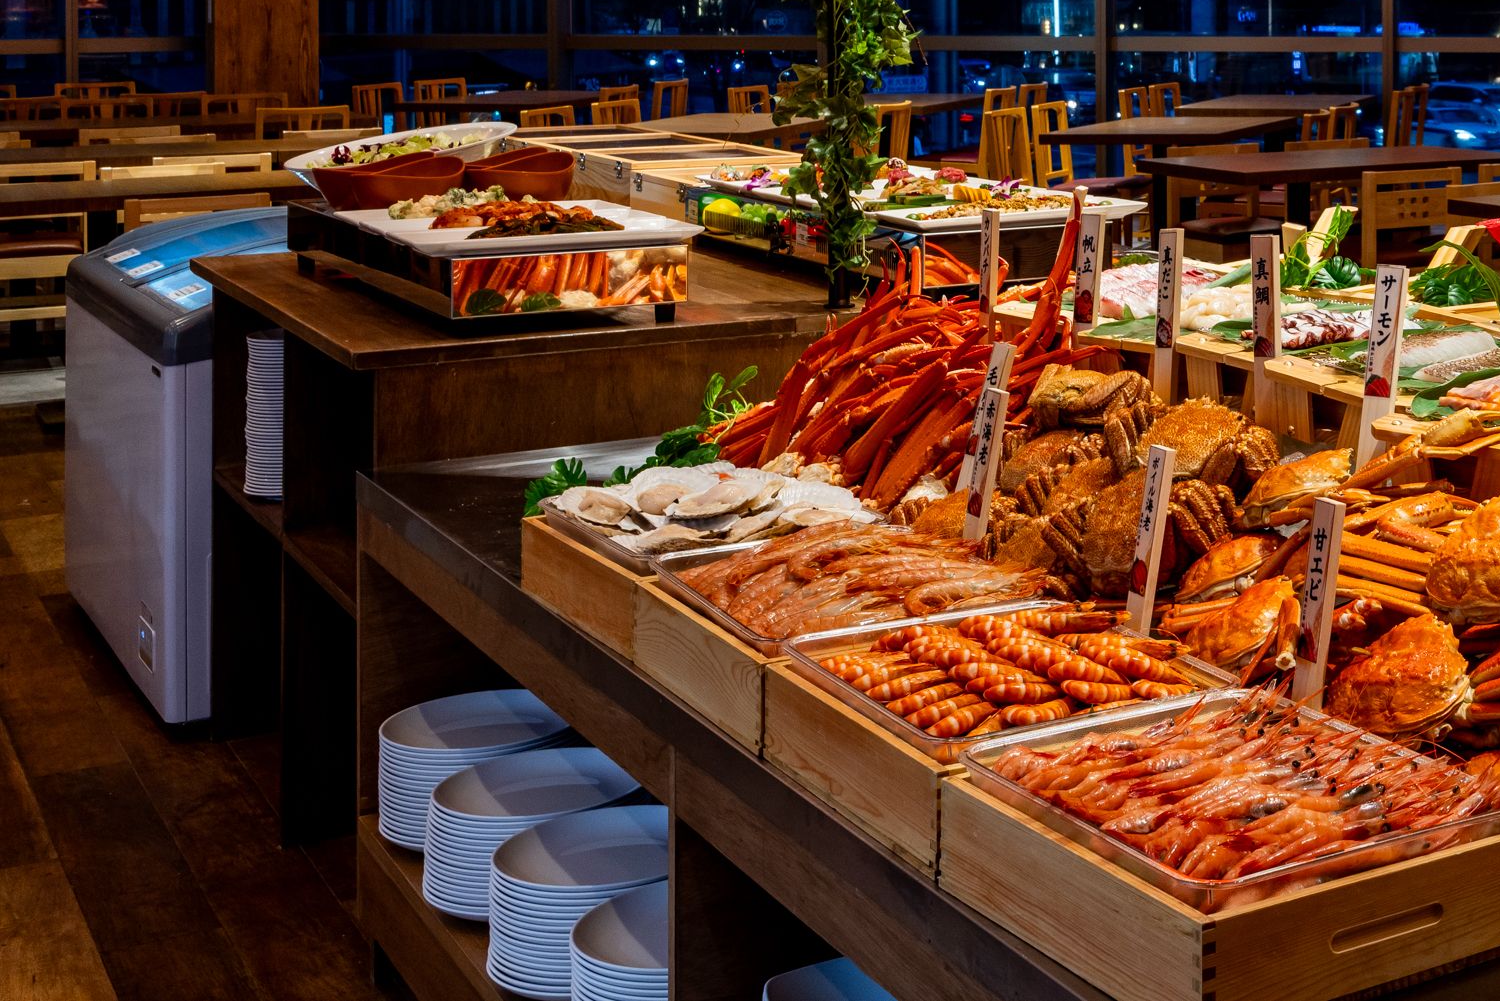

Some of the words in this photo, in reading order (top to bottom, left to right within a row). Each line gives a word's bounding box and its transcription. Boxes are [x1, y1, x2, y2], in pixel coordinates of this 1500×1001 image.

[1082, 234, 1096, 274] 帆立
[1162, 246, 1173, 300] 真だこ
[1254, 257, 1270, 306] 真鯛
[1377, 275, 1397, 347] サーモン
[978, 399, 996, 466] 赤海老
[1142, 457, 1161, 532] ボイル海老
[1309, 527, 1328, 602] 甘エビ
